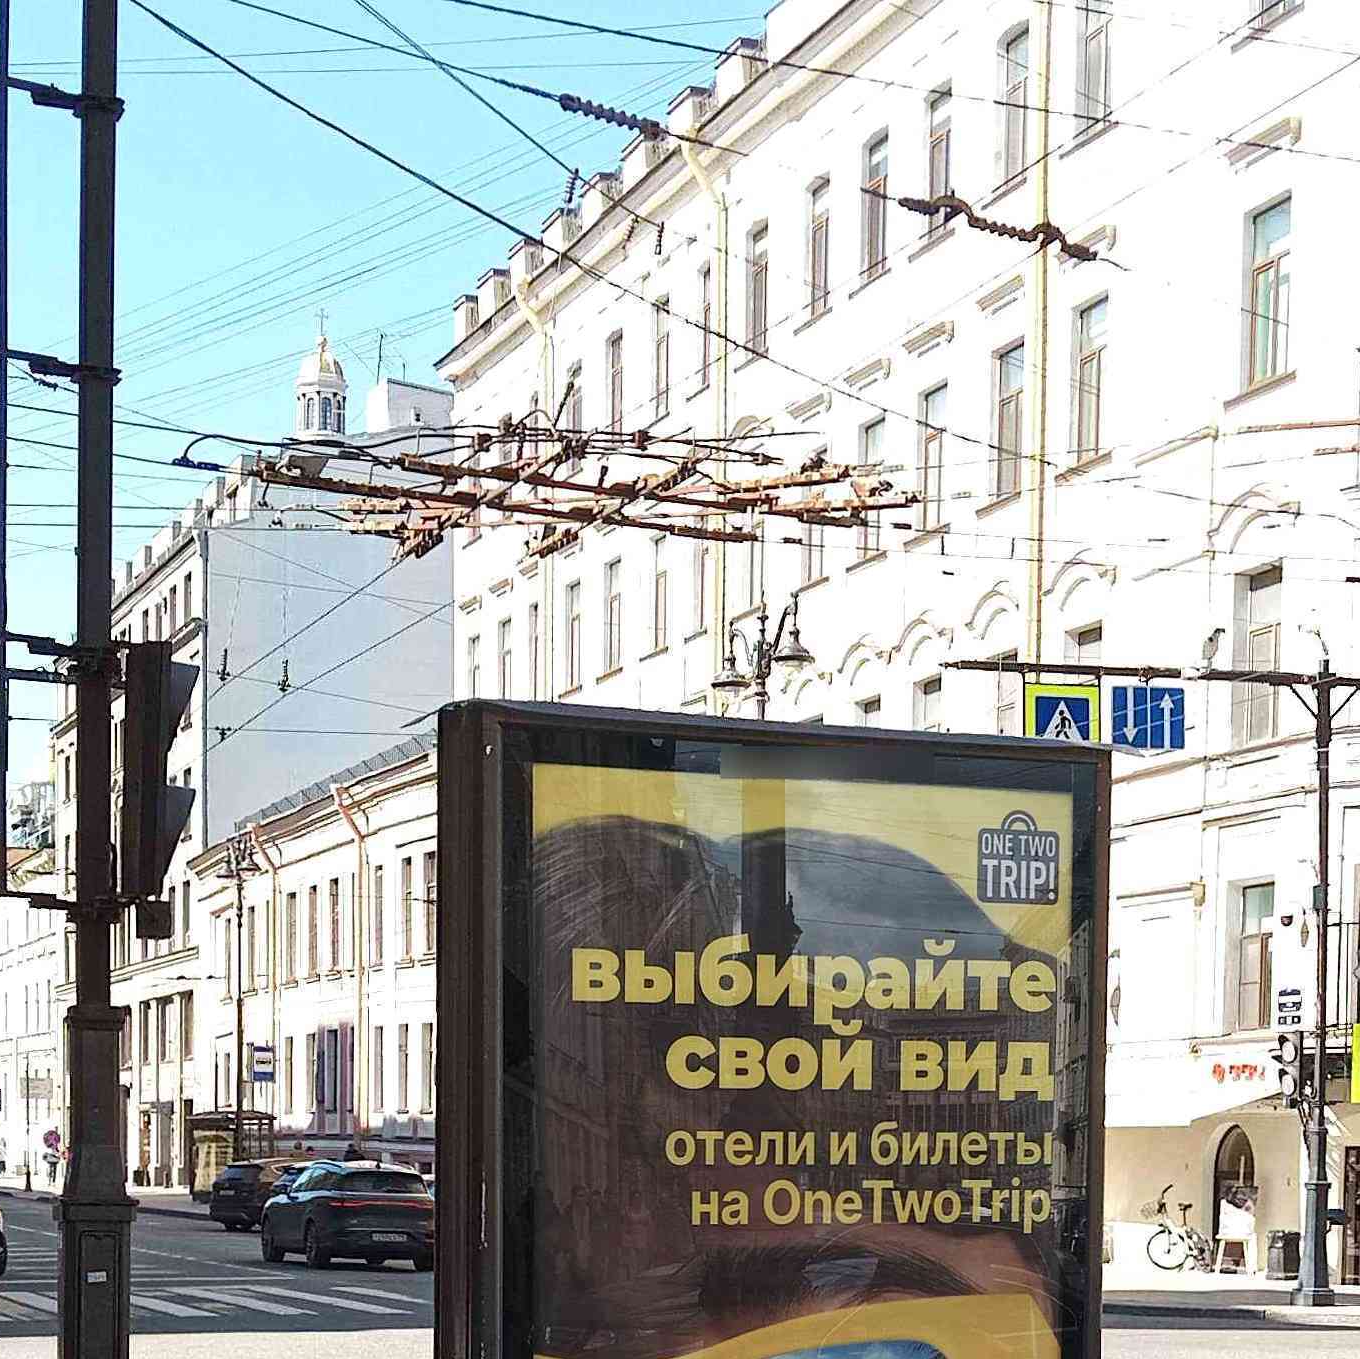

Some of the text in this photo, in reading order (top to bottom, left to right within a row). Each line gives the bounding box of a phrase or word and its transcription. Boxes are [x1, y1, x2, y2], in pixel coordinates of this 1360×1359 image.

[982, 833, 1056, 857] ONE TWO
[982, 859, 1056, 900] TRIP!
[571, 933, 1057, 1025] выбирайте
[665, 1018, 1055, 1101] свой вид
[665, 1120, 1053, 1167] отели и билеты
[690, 1176, 1052, 1234] на OneTwoTrip
